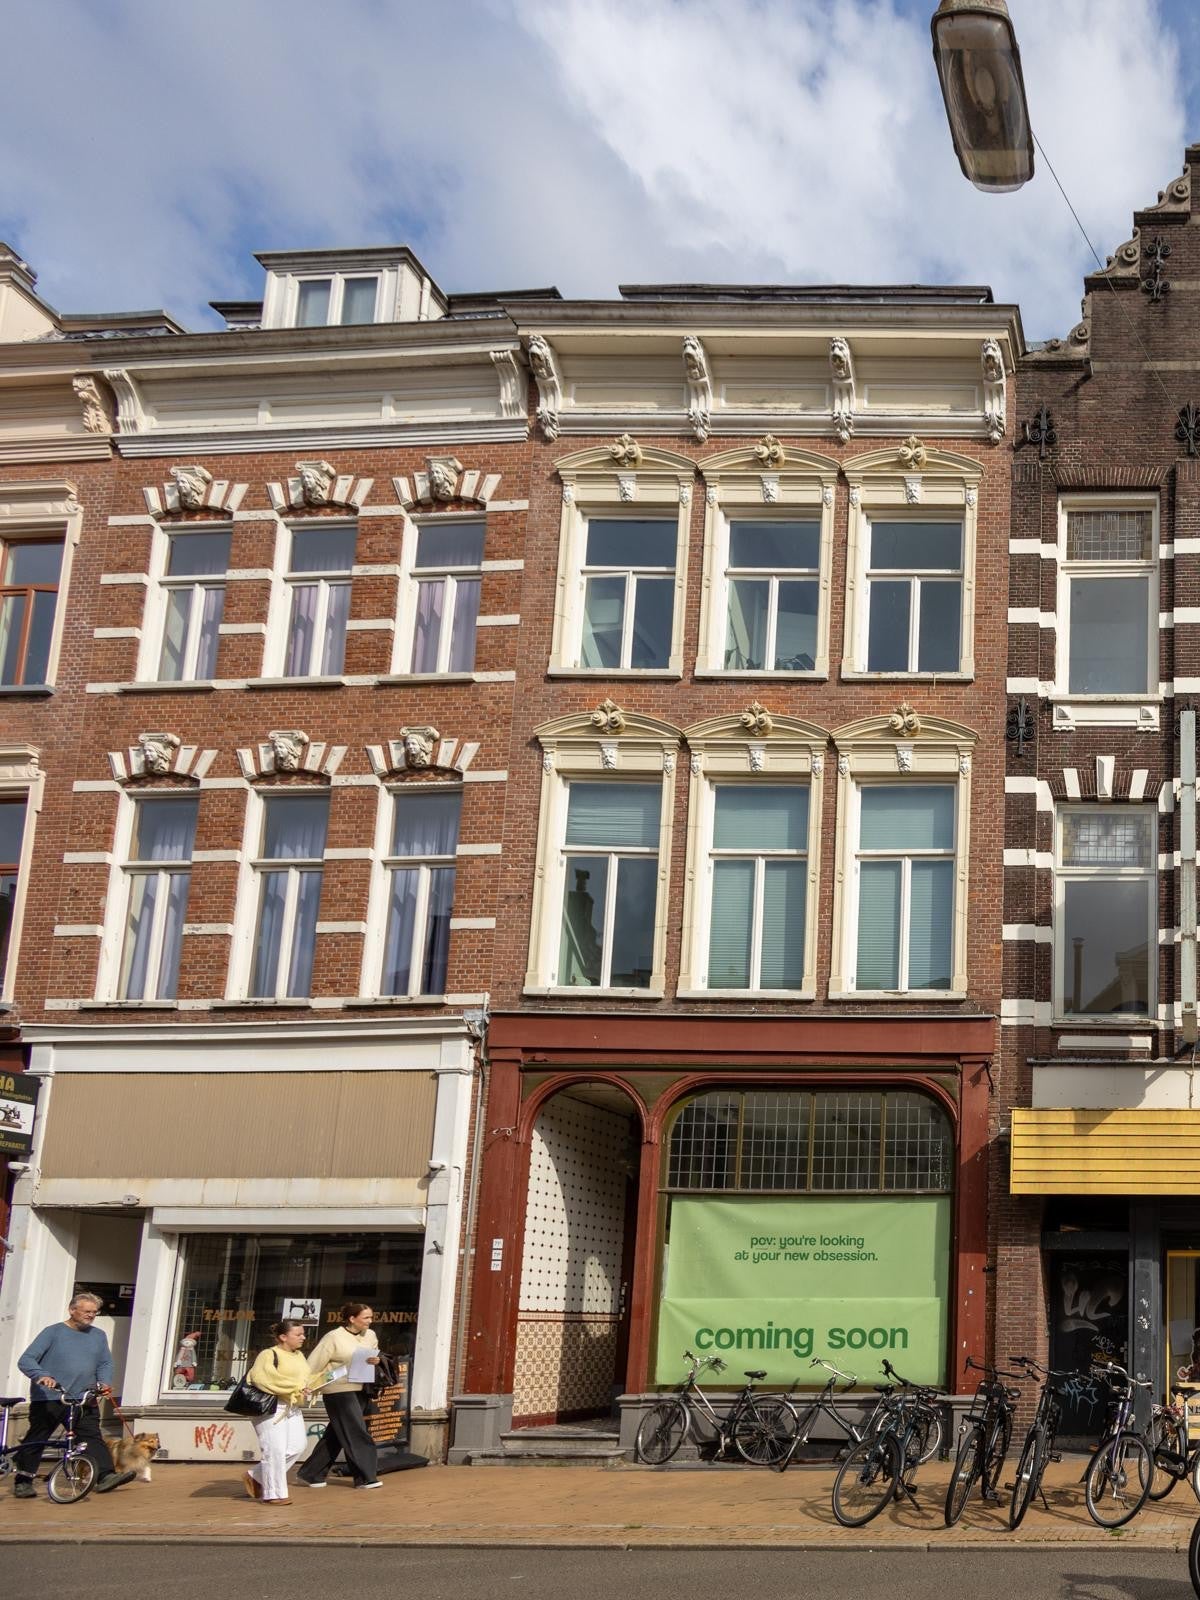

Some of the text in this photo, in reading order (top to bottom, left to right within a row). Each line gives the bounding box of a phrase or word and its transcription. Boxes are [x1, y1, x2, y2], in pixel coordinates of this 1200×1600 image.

[750, 1235, 865, 1249] pov: you're looking
[734, 1250, 878, 1264] at your new obsession.
[203, 1309, 256, 1321] TAILOR
[695, 1321, 908, 1358] coming soon
